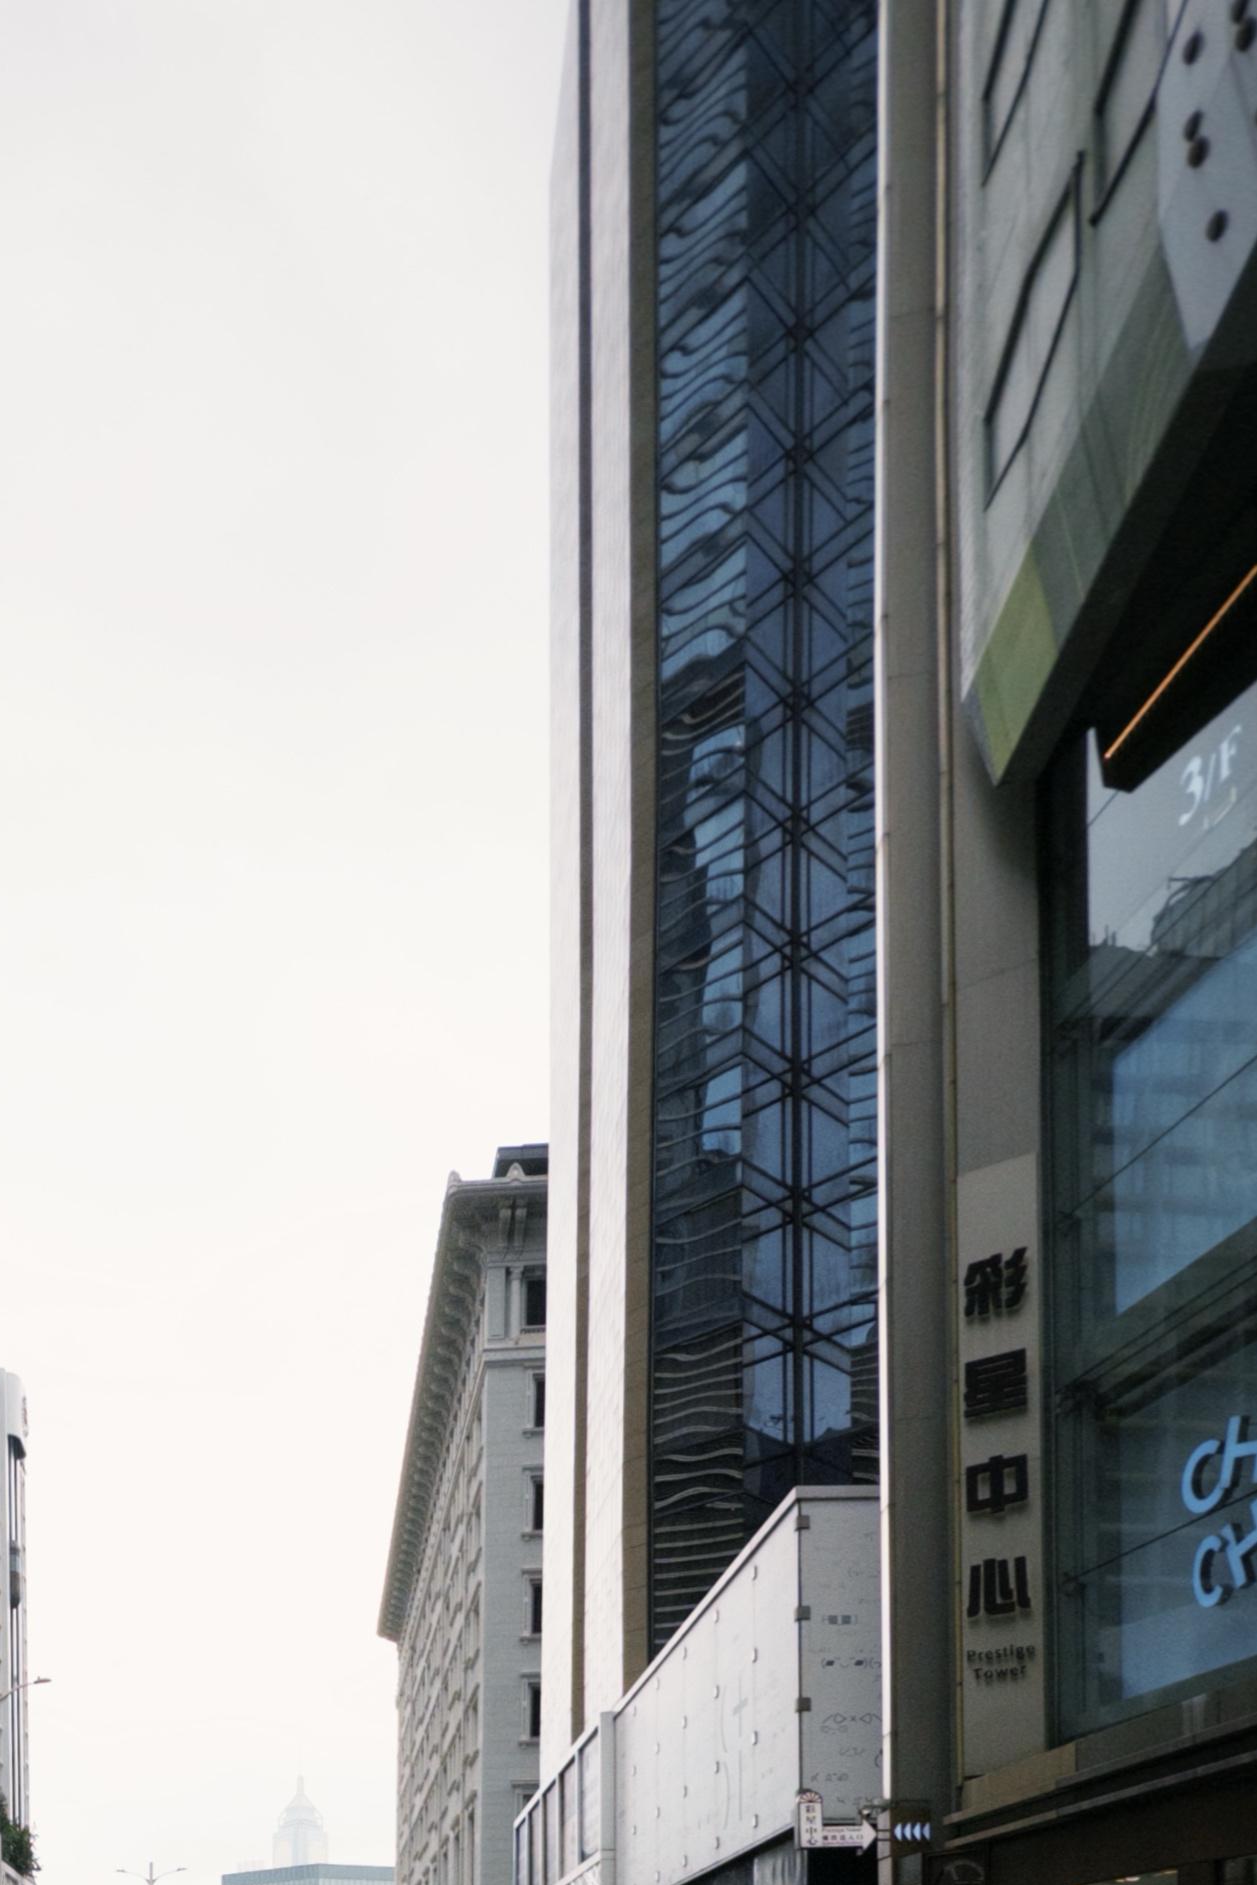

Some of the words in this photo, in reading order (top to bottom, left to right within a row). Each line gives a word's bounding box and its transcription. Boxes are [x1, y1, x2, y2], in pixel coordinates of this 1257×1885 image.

[1179, 724, 1242, 826] 3/F
[964, 1247, 1031, 1617] 彩星中心
[967, 1644, 1035, 1661] Prestige
[973, 1665, 1026, 1680] Tower
